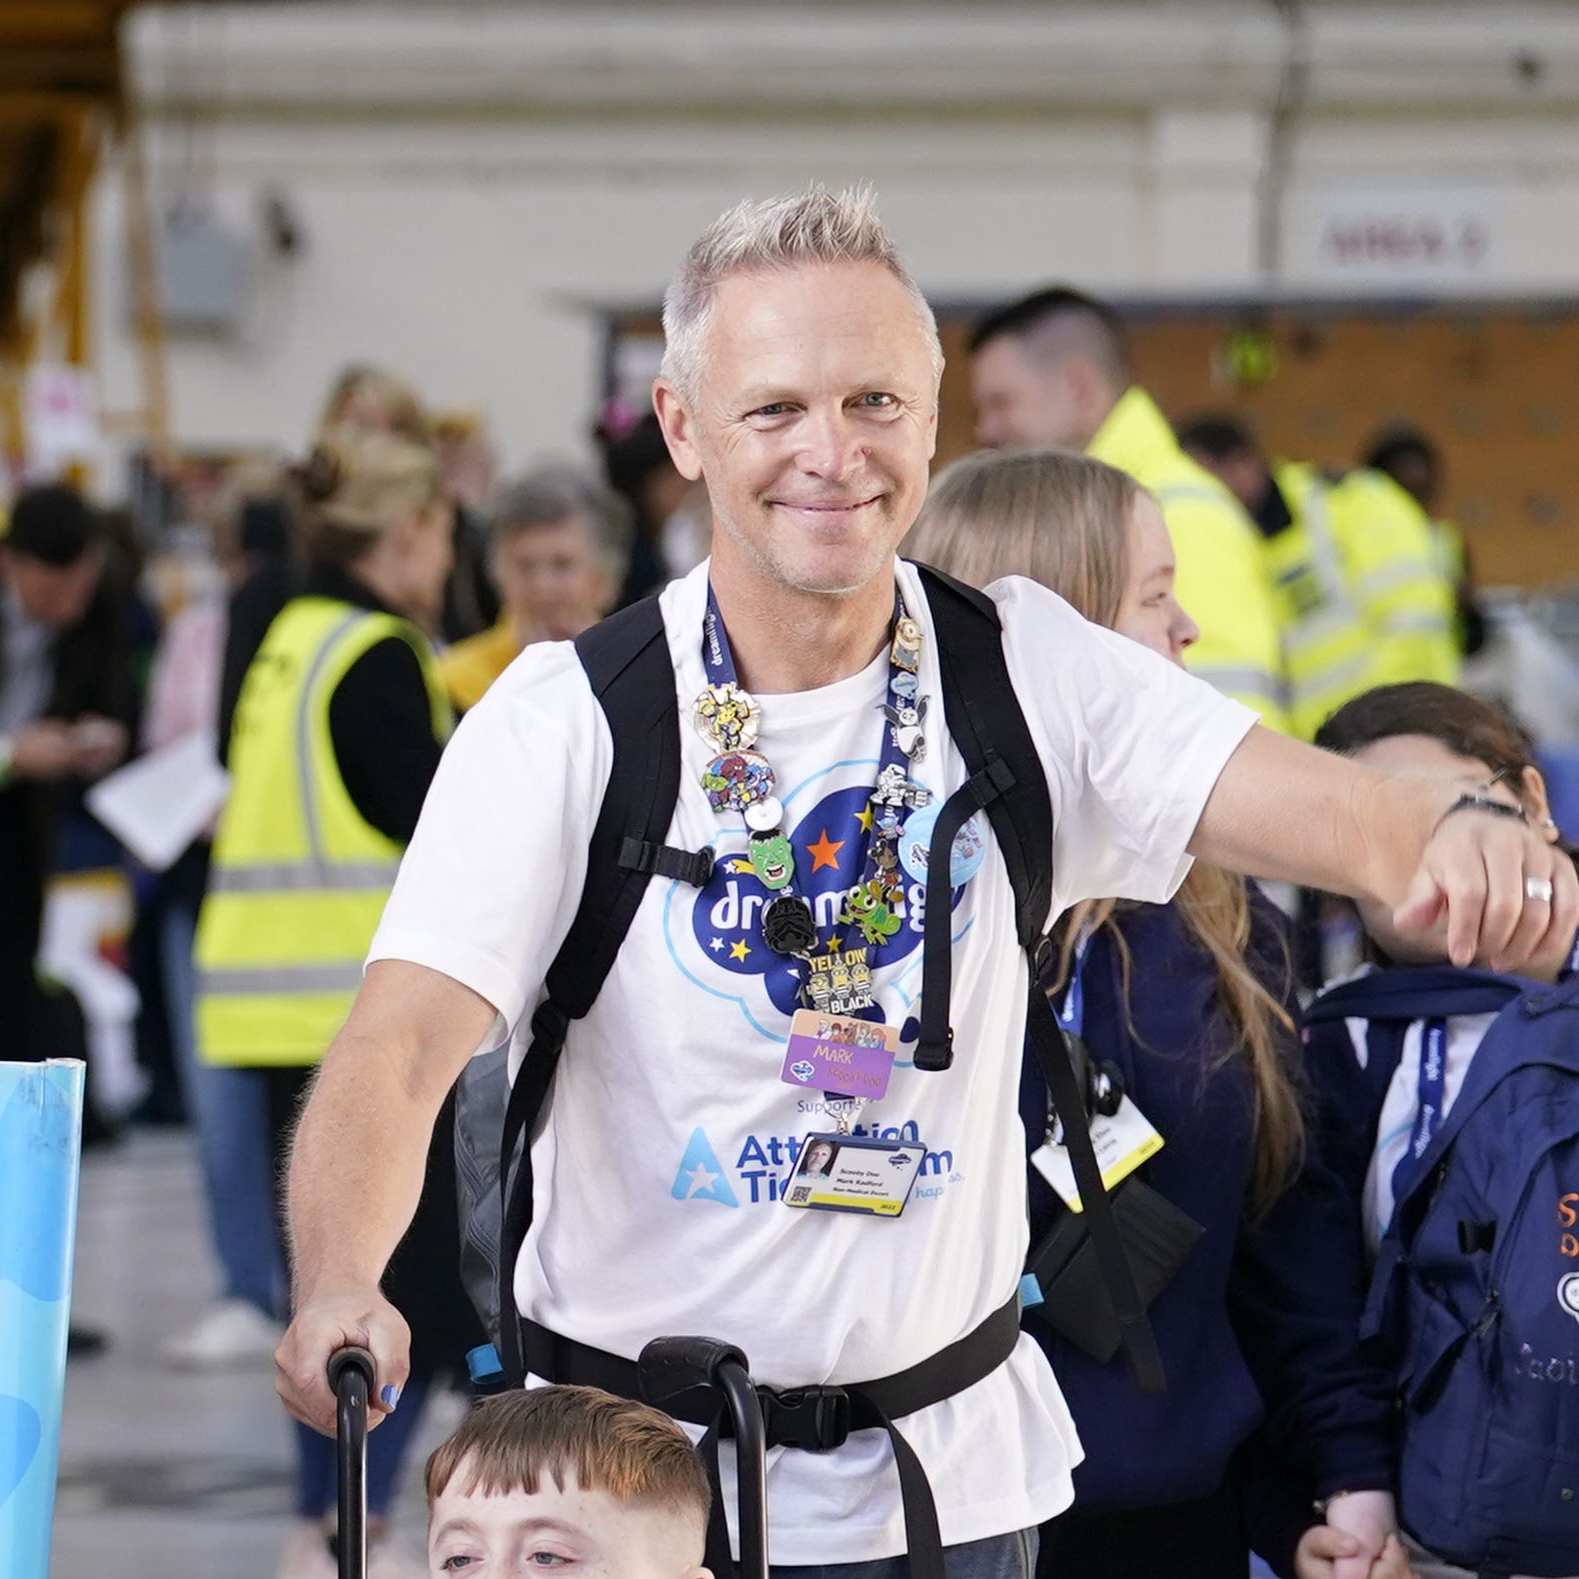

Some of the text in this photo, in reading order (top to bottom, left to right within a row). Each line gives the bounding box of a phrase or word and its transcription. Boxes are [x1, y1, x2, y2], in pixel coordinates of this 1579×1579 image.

[808, 948, 868, 973] YELLOW
[830, 994, 875, 1014] BLACK
[812, 1045, 855, 1065] MARK
